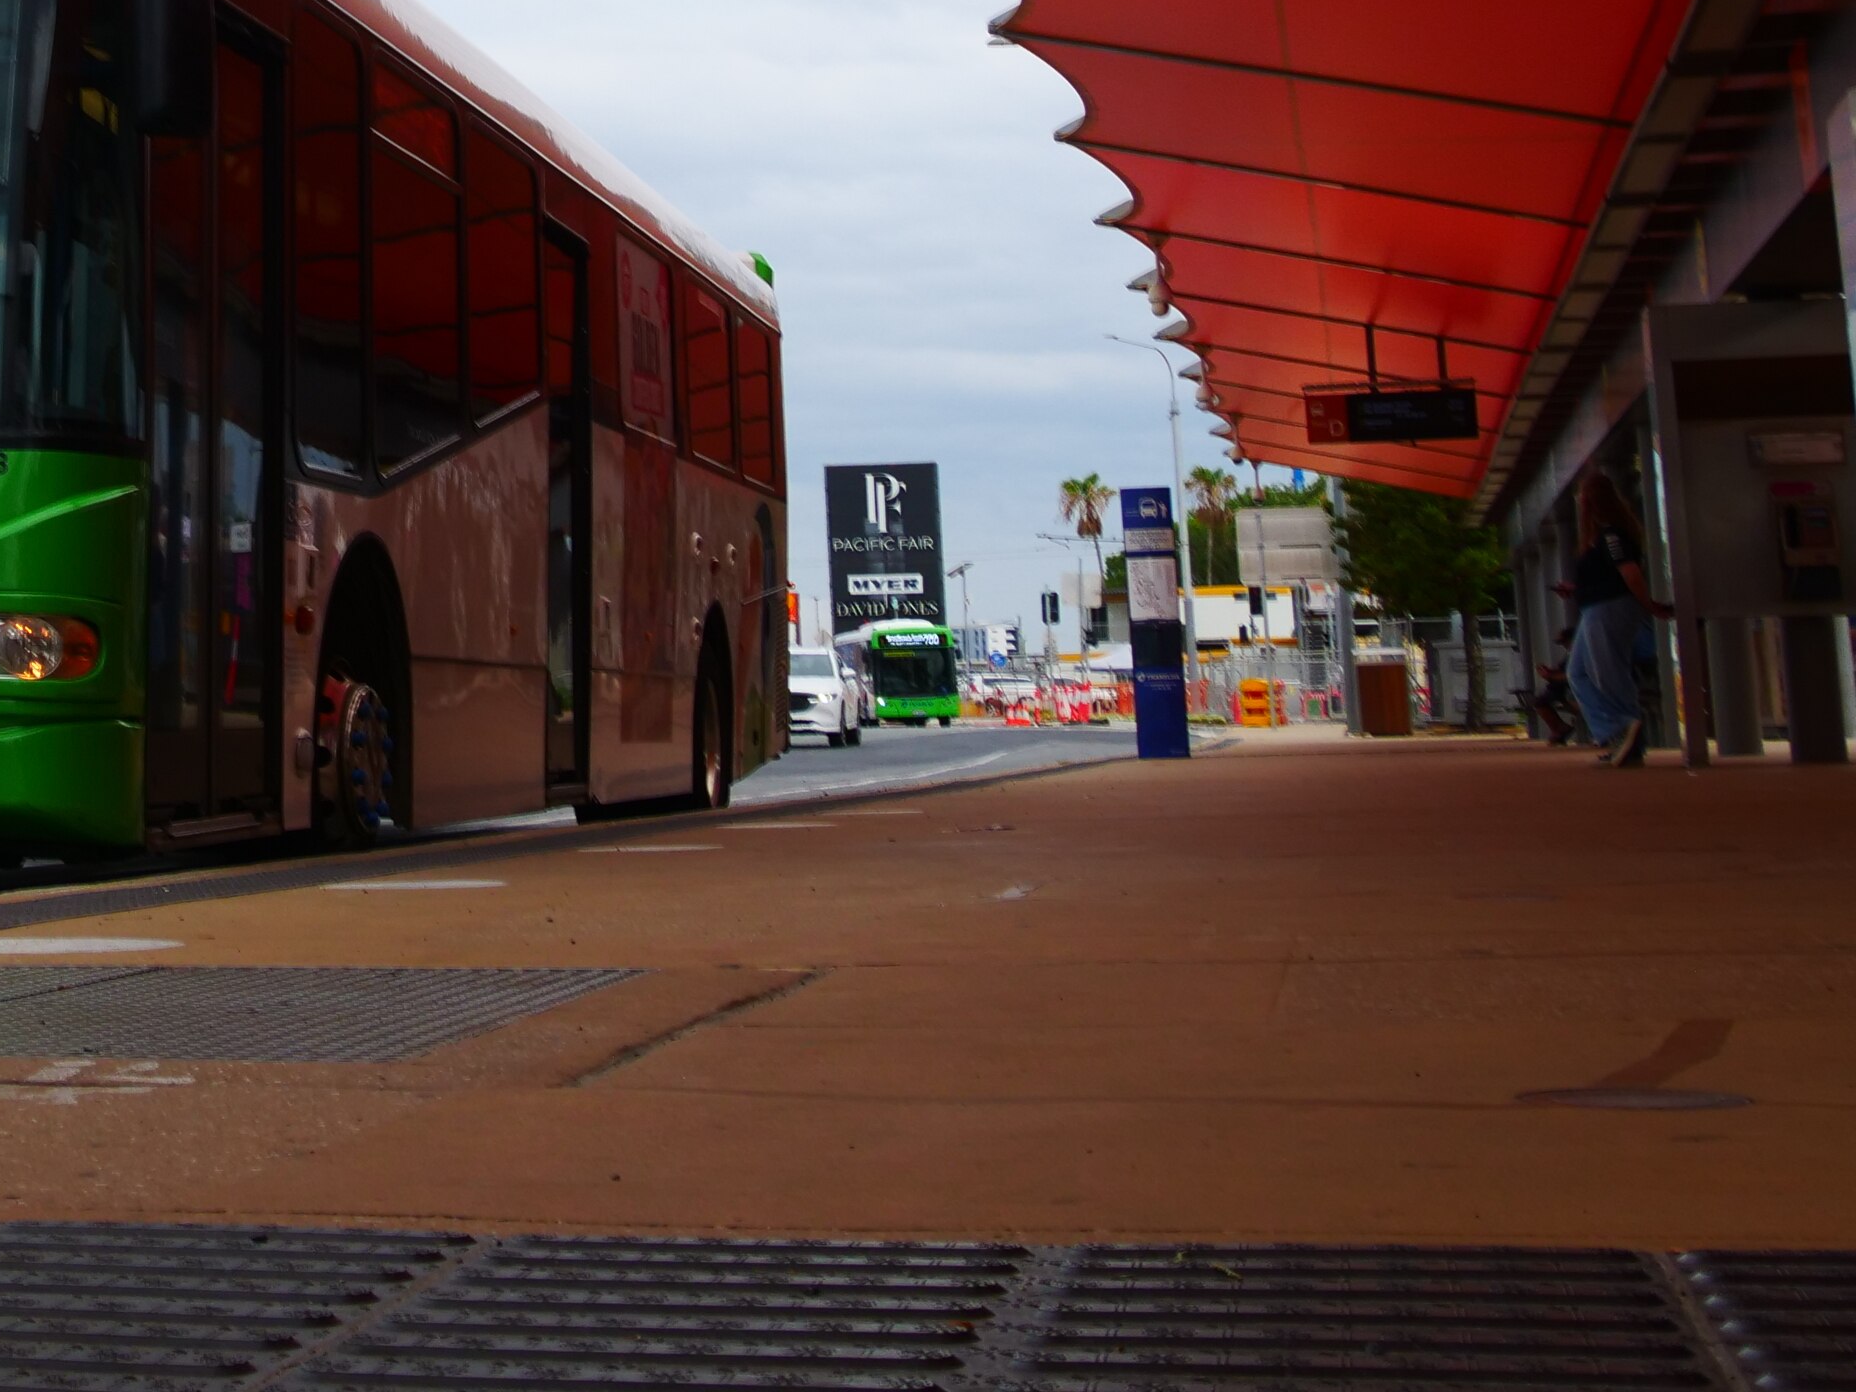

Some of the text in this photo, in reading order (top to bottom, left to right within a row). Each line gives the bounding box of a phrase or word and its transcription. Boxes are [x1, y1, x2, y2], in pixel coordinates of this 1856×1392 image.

[832, 534, 935, 553] PACIFIC FAIR
[852, 579, 920, 591] MYER
[835, 600, 887, 617] DAVID
